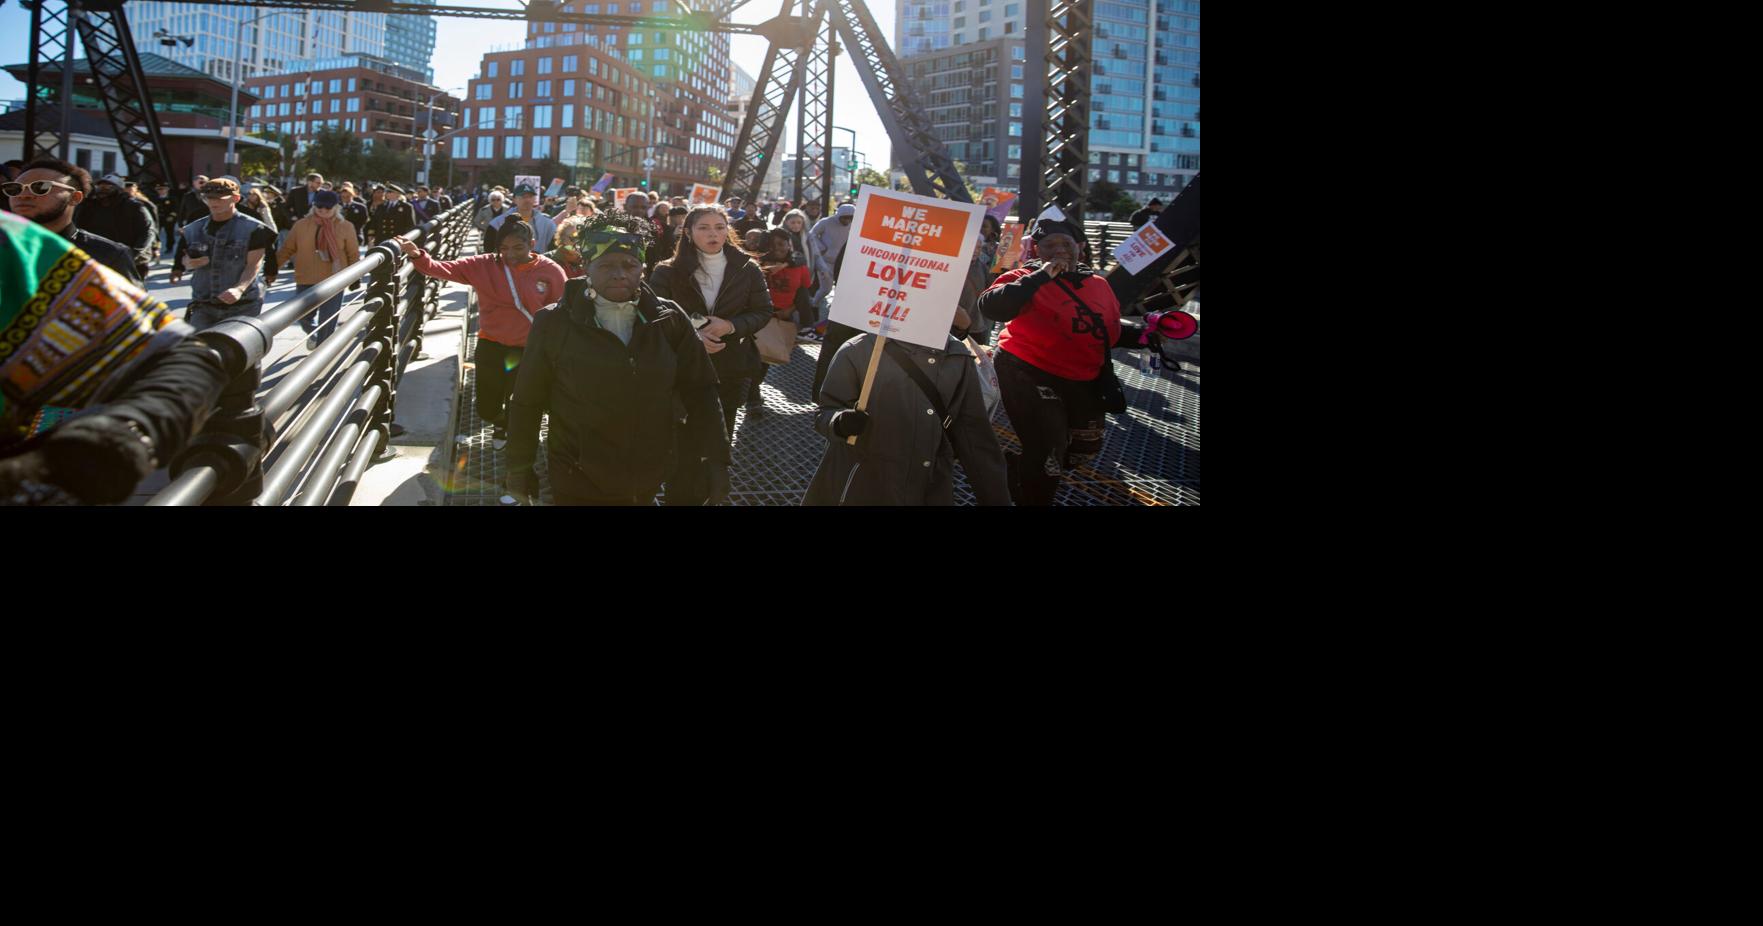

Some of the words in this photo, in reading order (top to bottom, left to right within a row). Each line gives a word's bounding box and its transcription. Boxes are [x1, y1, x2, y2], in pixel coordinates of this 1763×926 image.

[901, 205, 928, 221] WE
[881, 215, 943, 238] MARCH
[892, 231, 923, 246] FOR
[860, 245, 950, 273] UNCONDITIONAL
[866, 261, 931, 290] LOVE
[878, 286, 907, 301] FOR
[868, 300, 911, 322] ALL!
